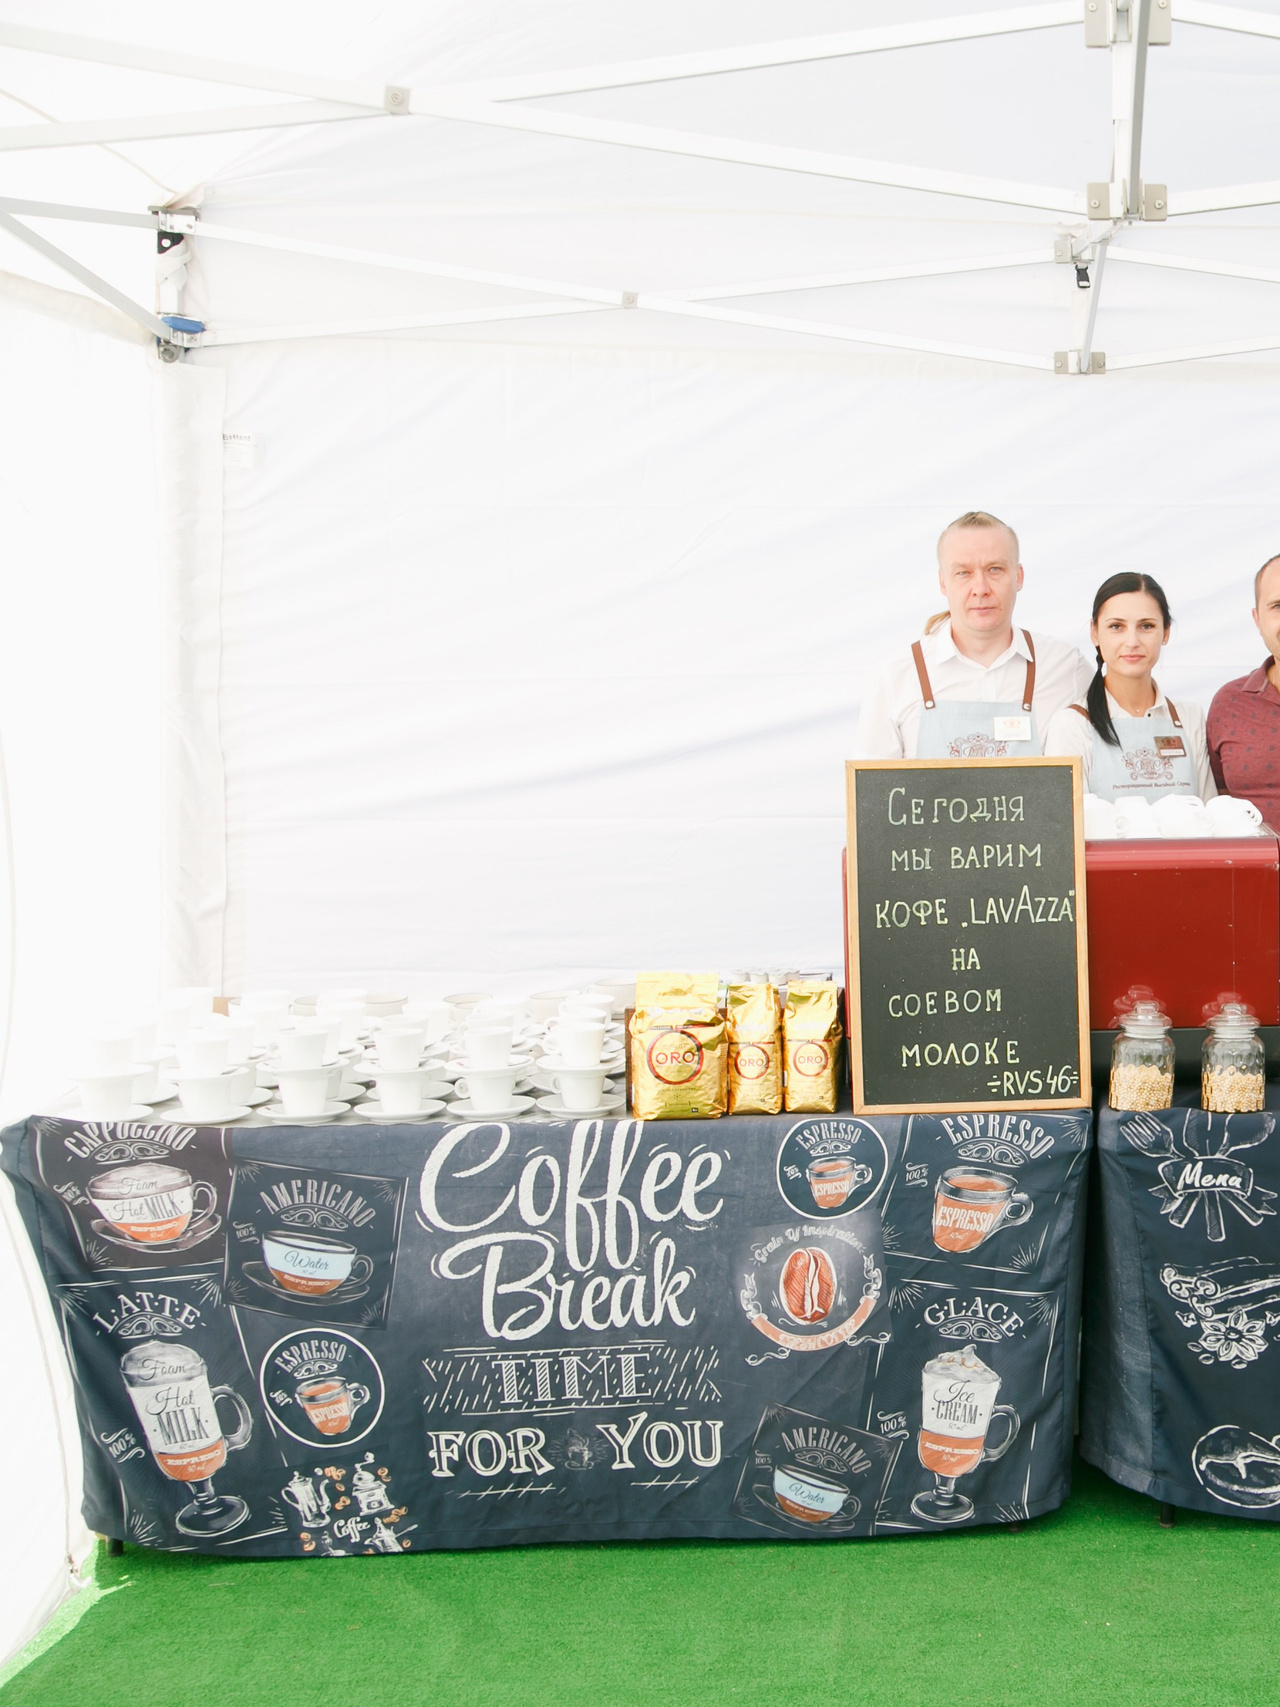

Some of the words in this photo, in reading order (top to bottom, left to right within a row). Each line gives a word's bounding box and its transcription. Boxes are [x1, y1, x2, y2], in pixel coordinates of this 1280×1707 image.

[655, 1050, 695, 1065] ORO
[739, 1058, 764, 1067] ORO
[798, 1055, 823, 1064] ORO
[795, 1121, 862, 1150] ESPRESSO
[940, 1113, 1055, 1159] ESPRESSO
[118, 1177, 158, 1196] Foam
[420, 1120, 724, 1273] Coffee
[144, 1192, 183, 1220] MILK
[259, 1179, 376, 1228] AMERICANO
[935, 1206, 994, 1233] ESPRESSO
[283, 1250, 330, 1271] Water
[438, 1231, 697, 1341] Break
[138, 1358, 188, 1381] Foam
[274, 1339, 348, 1374] ESPRESSO
[491, 1353, 653, 1404] TIME
[933, 1380, 975, 1403] Ice
[145, 1387, 195, 1415] Hot
[935, 1399, 978, 1425] CREAM
[156, 1406, 210, 1446] MILK
[880, 1415, 907, 1434] 100%
[108, 1432, 137, 1458] 100%
[427, 1427, 555, 1478] FOR
[595, 1411, 724, 1471] YOU
[781, 1426, 872, 1474] AMERICANO
[789, 1482, 825, 1504] Water
[332, 1516, 371, 1543] Coffee
